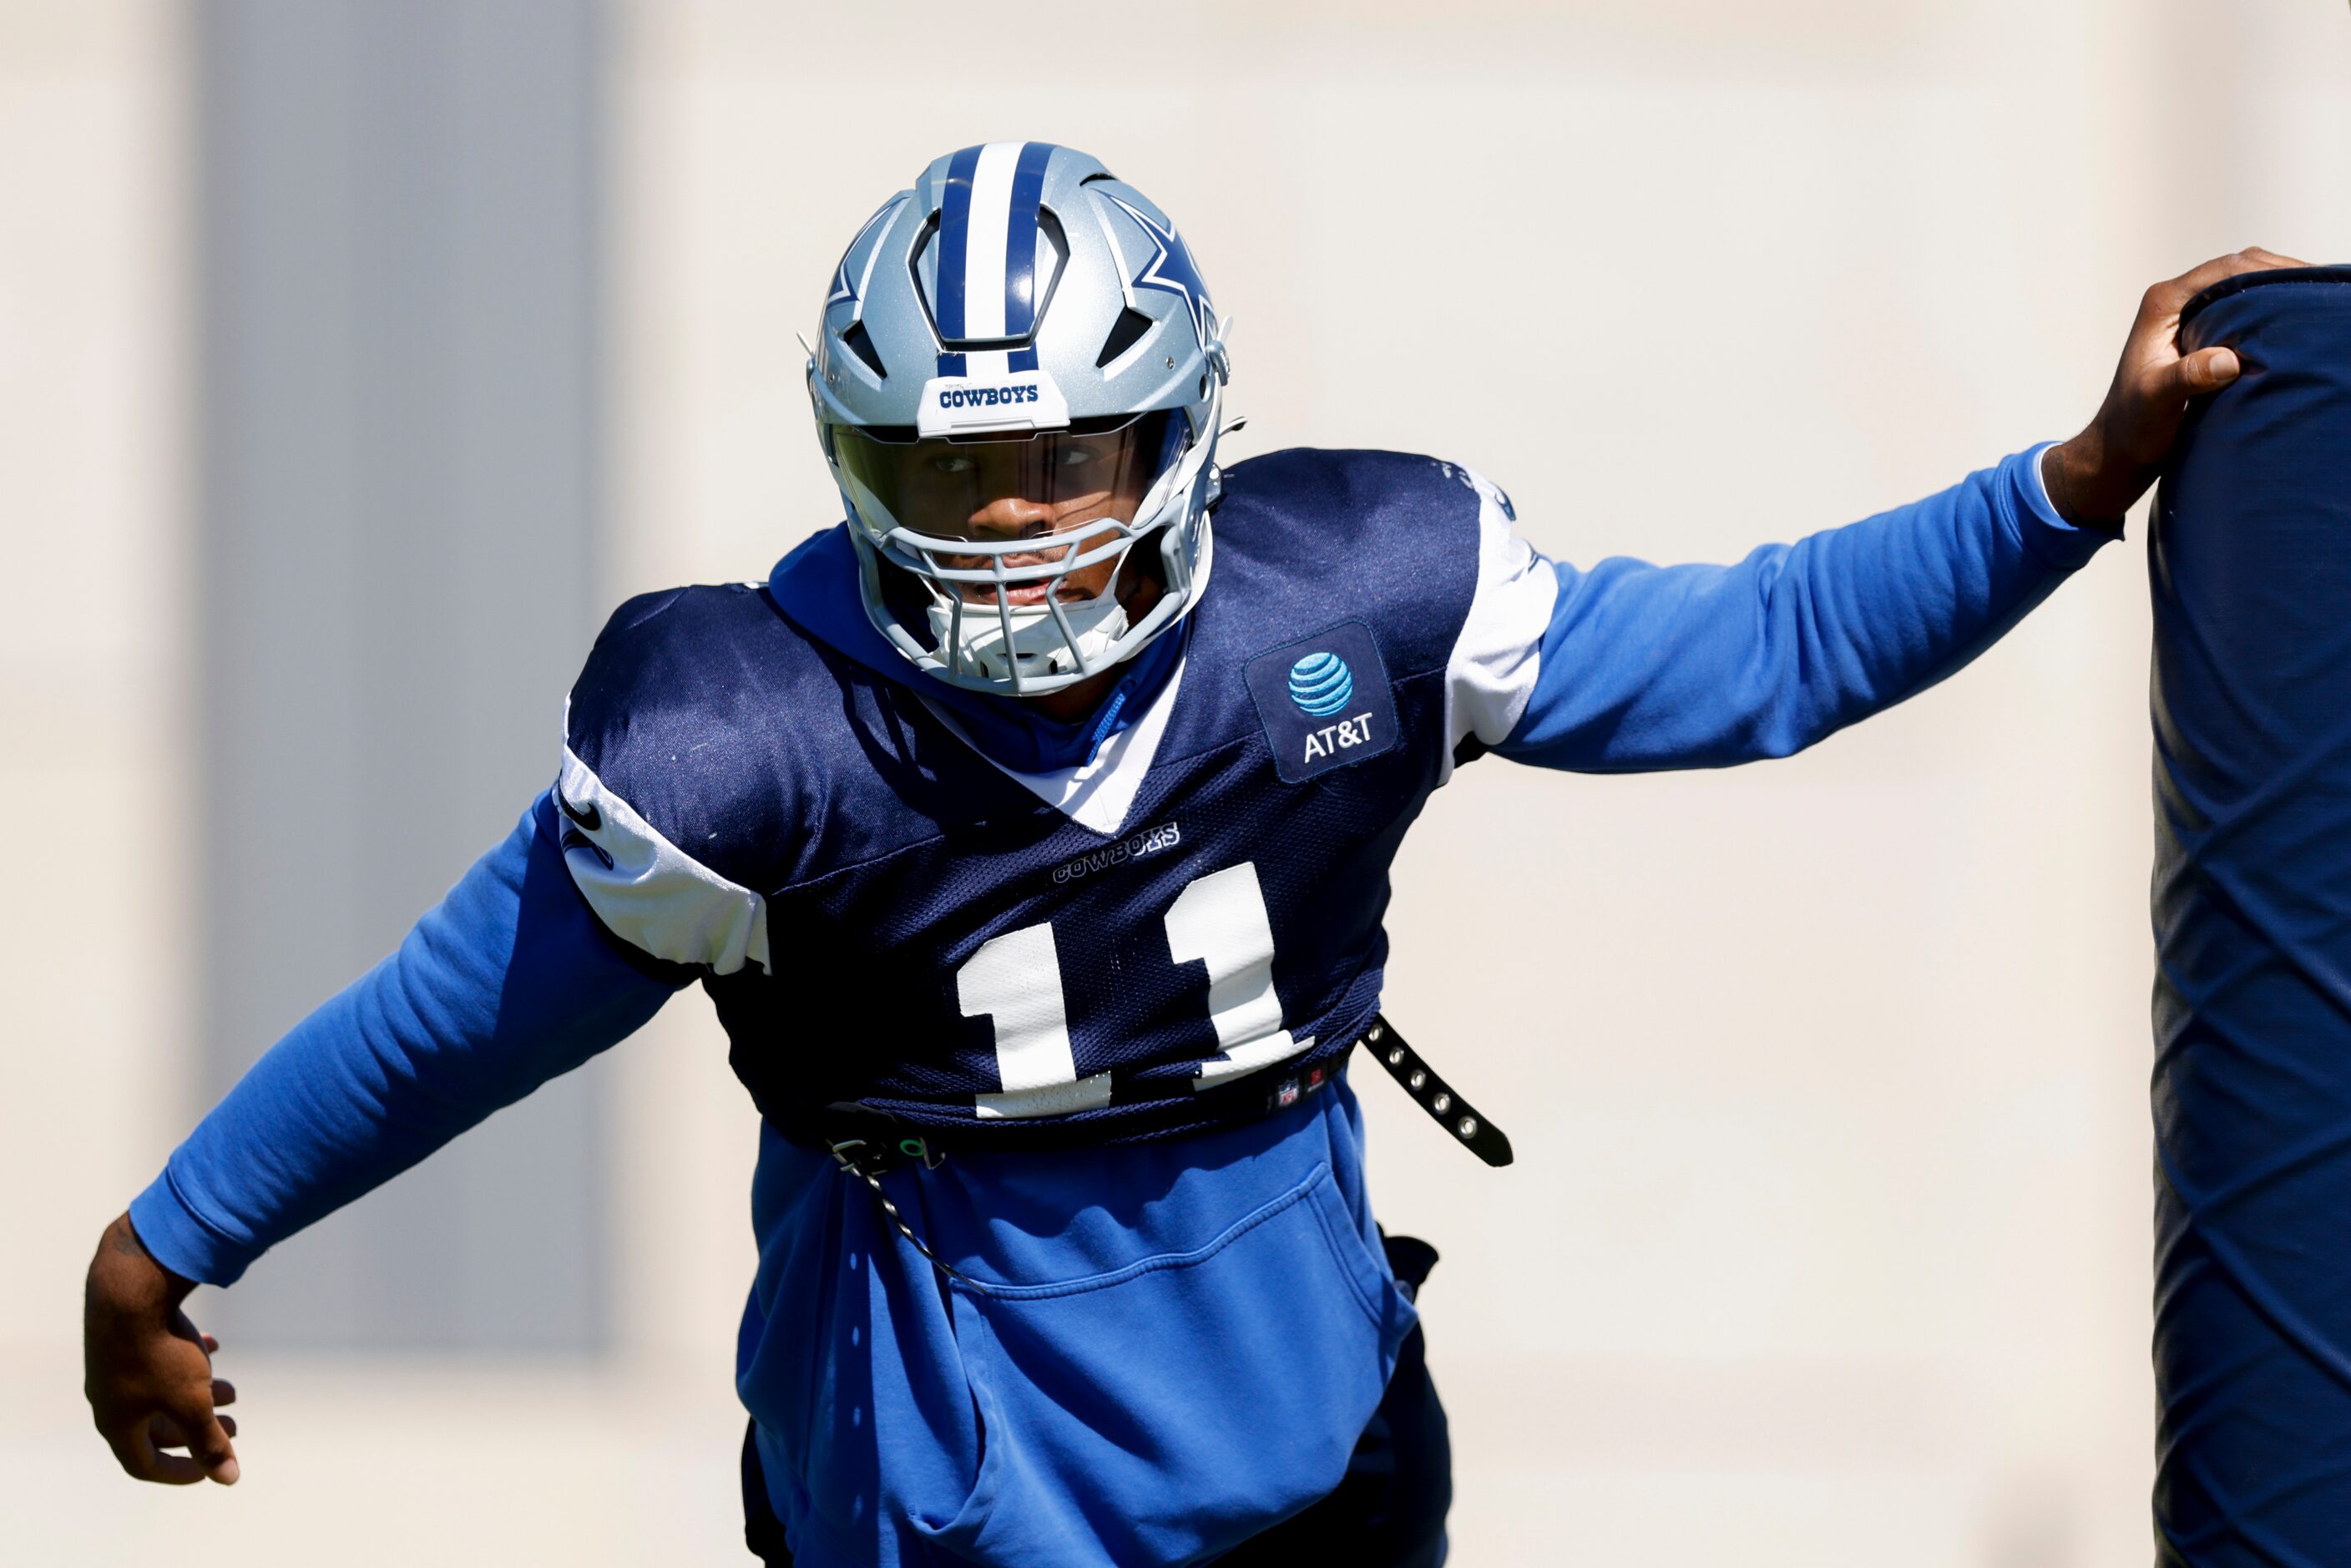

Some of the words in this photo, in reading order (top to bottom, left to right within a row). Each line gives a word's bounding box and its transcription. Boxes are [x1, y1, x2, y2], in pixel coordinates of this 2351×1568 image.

[939, 384, 1039, 408] COWBOYS
[1304, 712, 1373, 764] AT&T
[1052, 821, 1181, 883] COWBOYS
[957, 861, 1316, 1119] 11
